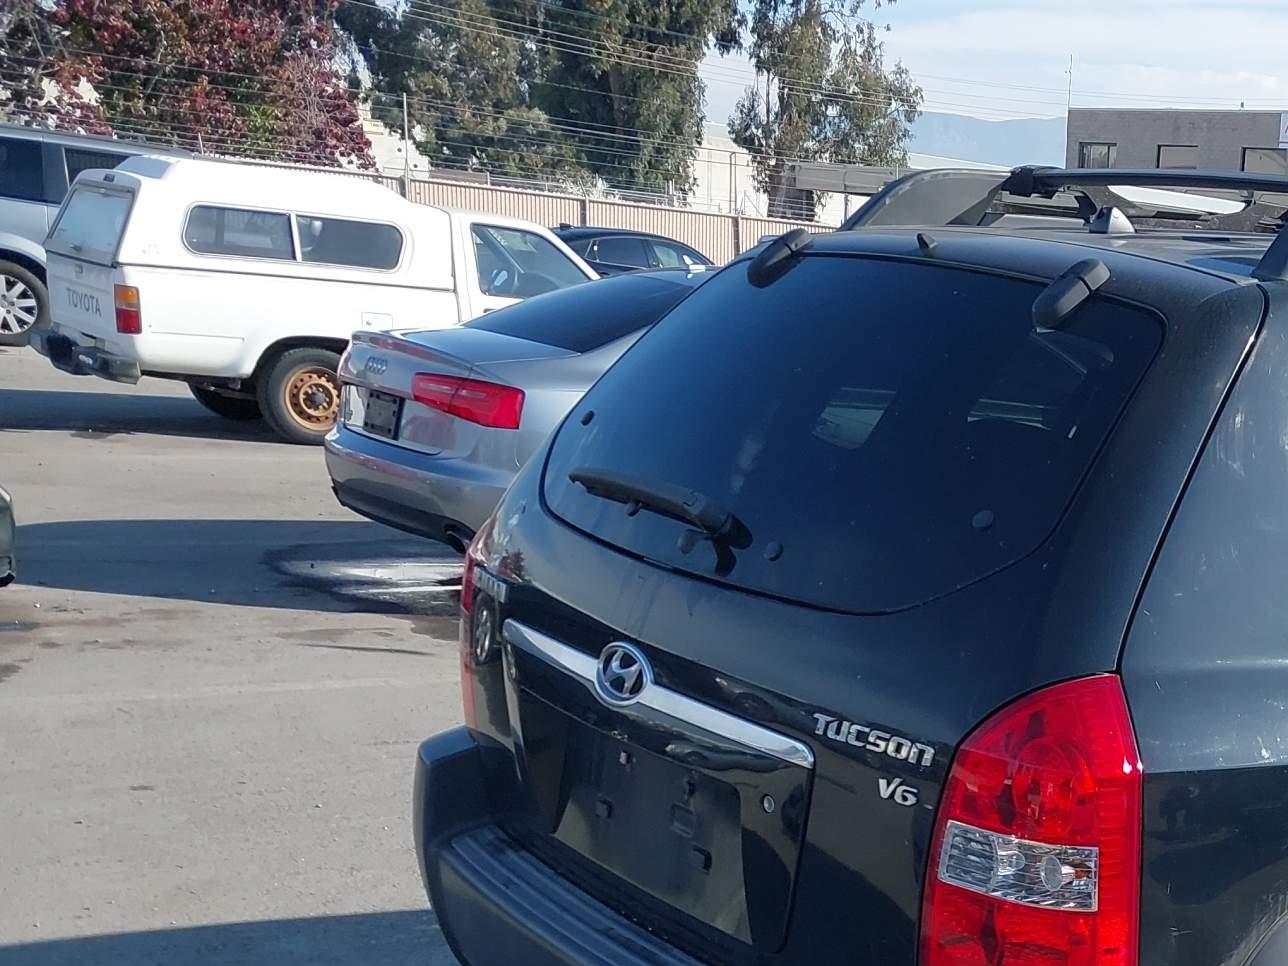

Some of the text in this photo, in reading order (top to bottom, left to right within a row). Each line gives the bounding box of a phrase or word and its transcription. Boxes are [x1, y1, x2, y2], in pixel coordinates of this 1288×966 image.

[66, 287, 102, 317] TOYOTA
[813, 713, 935, 767] TUCSON
[878, 778, 918, 806] V6
